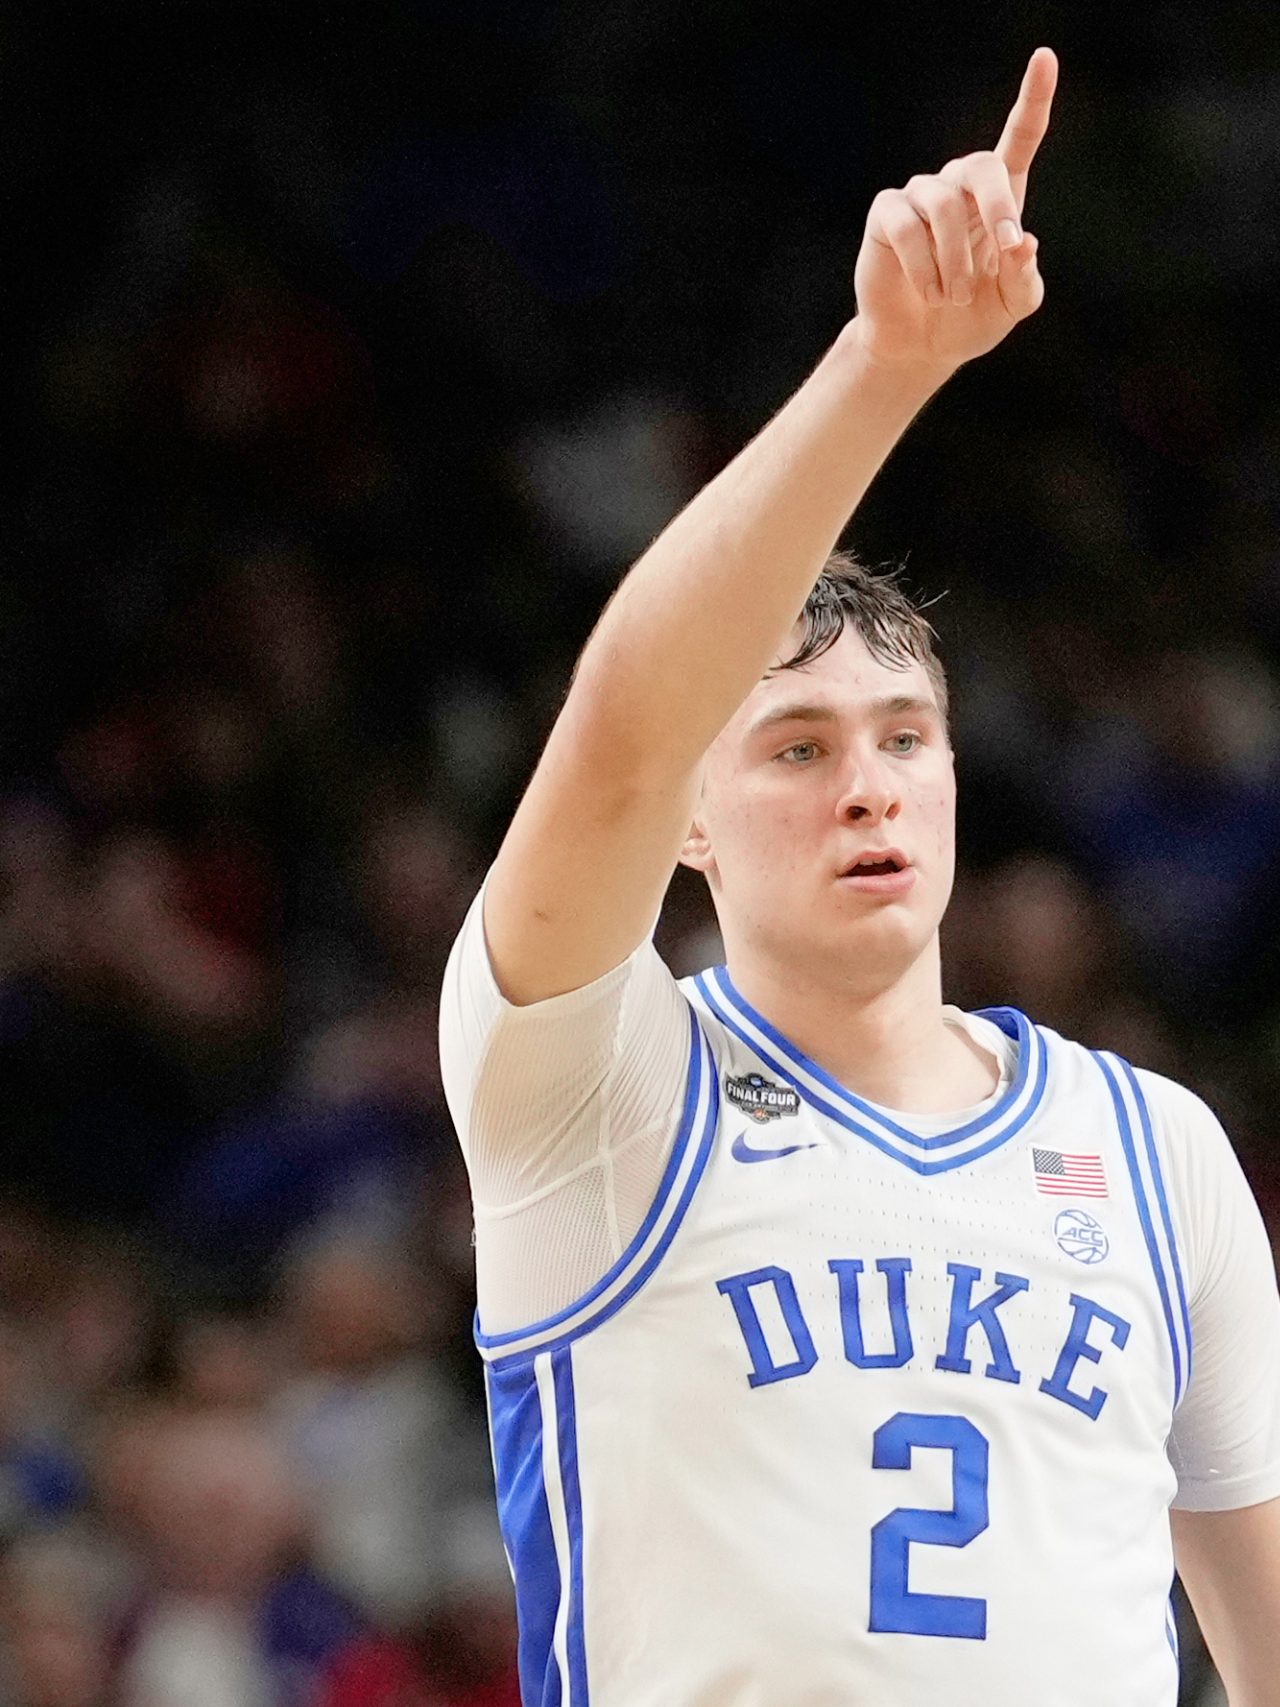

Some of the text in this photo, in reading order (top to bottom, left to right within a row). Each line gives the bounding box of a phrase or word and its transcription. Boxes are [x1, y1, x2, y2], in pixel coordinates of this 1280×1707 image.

[728, 1083, 760, 1102] FINAL
[761, 1092, 796, 1106] FOUR
[1062, 1227, 1104, 1245] ACC
[716, 1257, 1131, 1421] DUKE
[868, 1412, 989, 1640] 2
